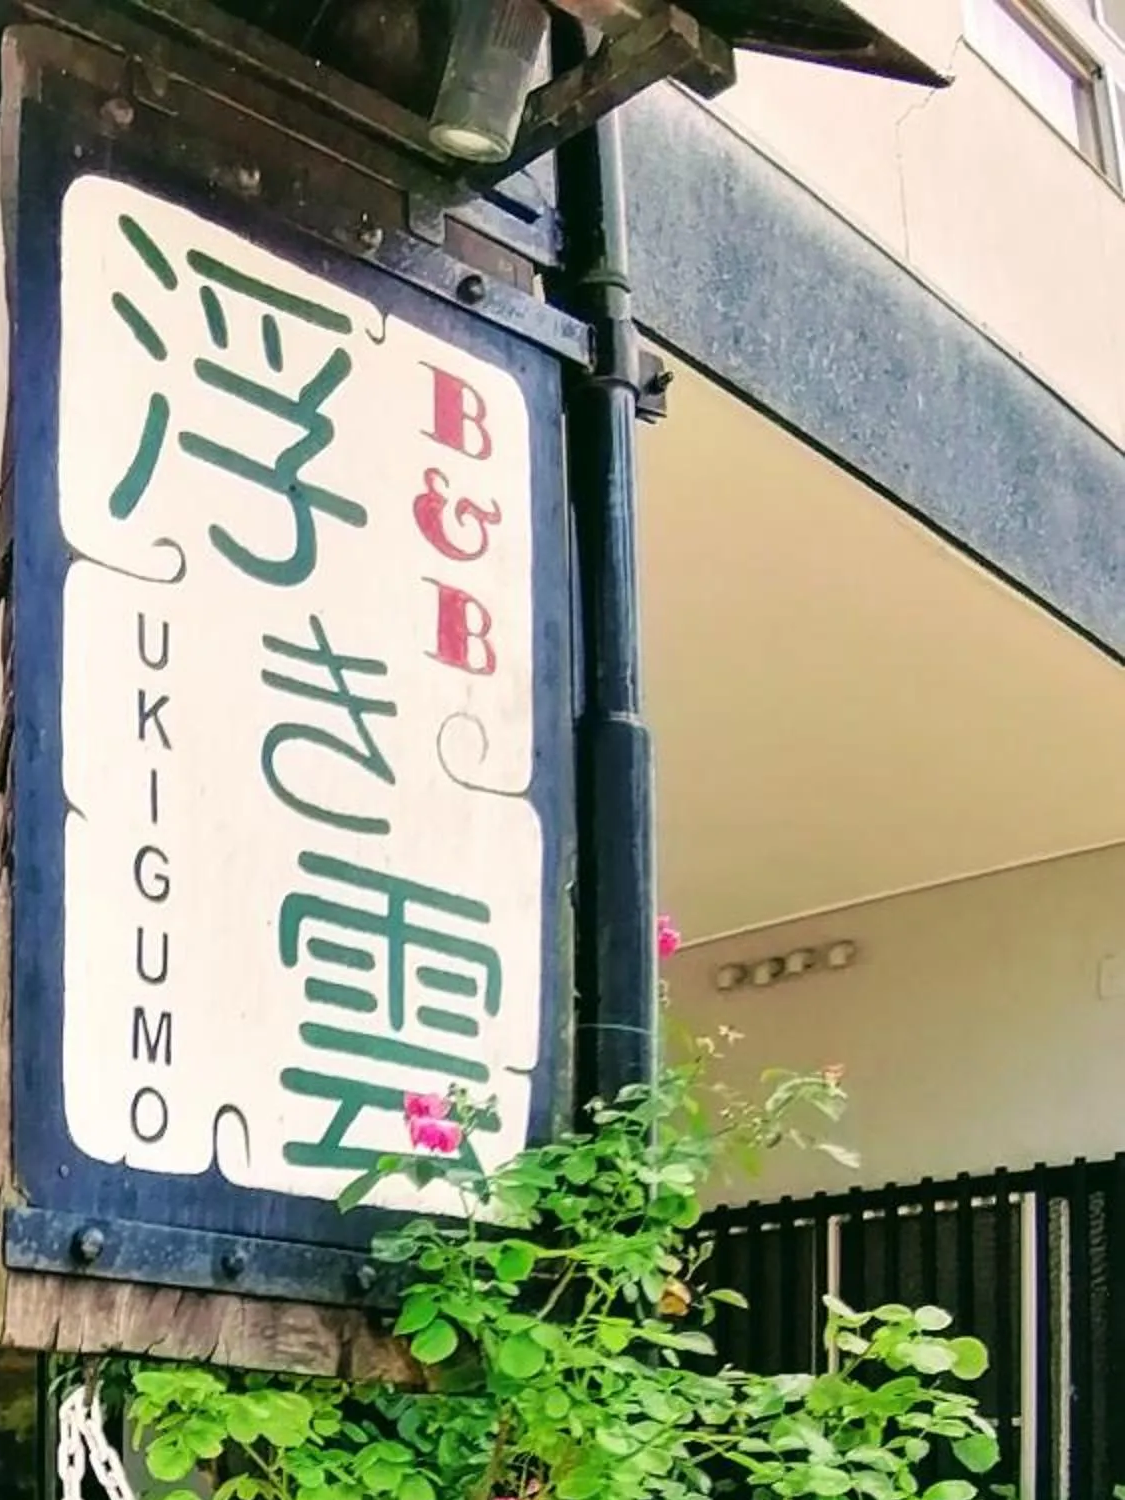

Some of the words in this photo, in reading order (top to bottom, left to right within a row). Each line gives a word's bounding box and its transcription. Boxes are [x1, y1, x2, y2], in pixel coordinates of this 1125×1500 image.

[110, 214, 502, 1204] 浮き雲
[413, 361, 502, 676] B&B
[129, 612, 173, 1145] UKIGUMO
